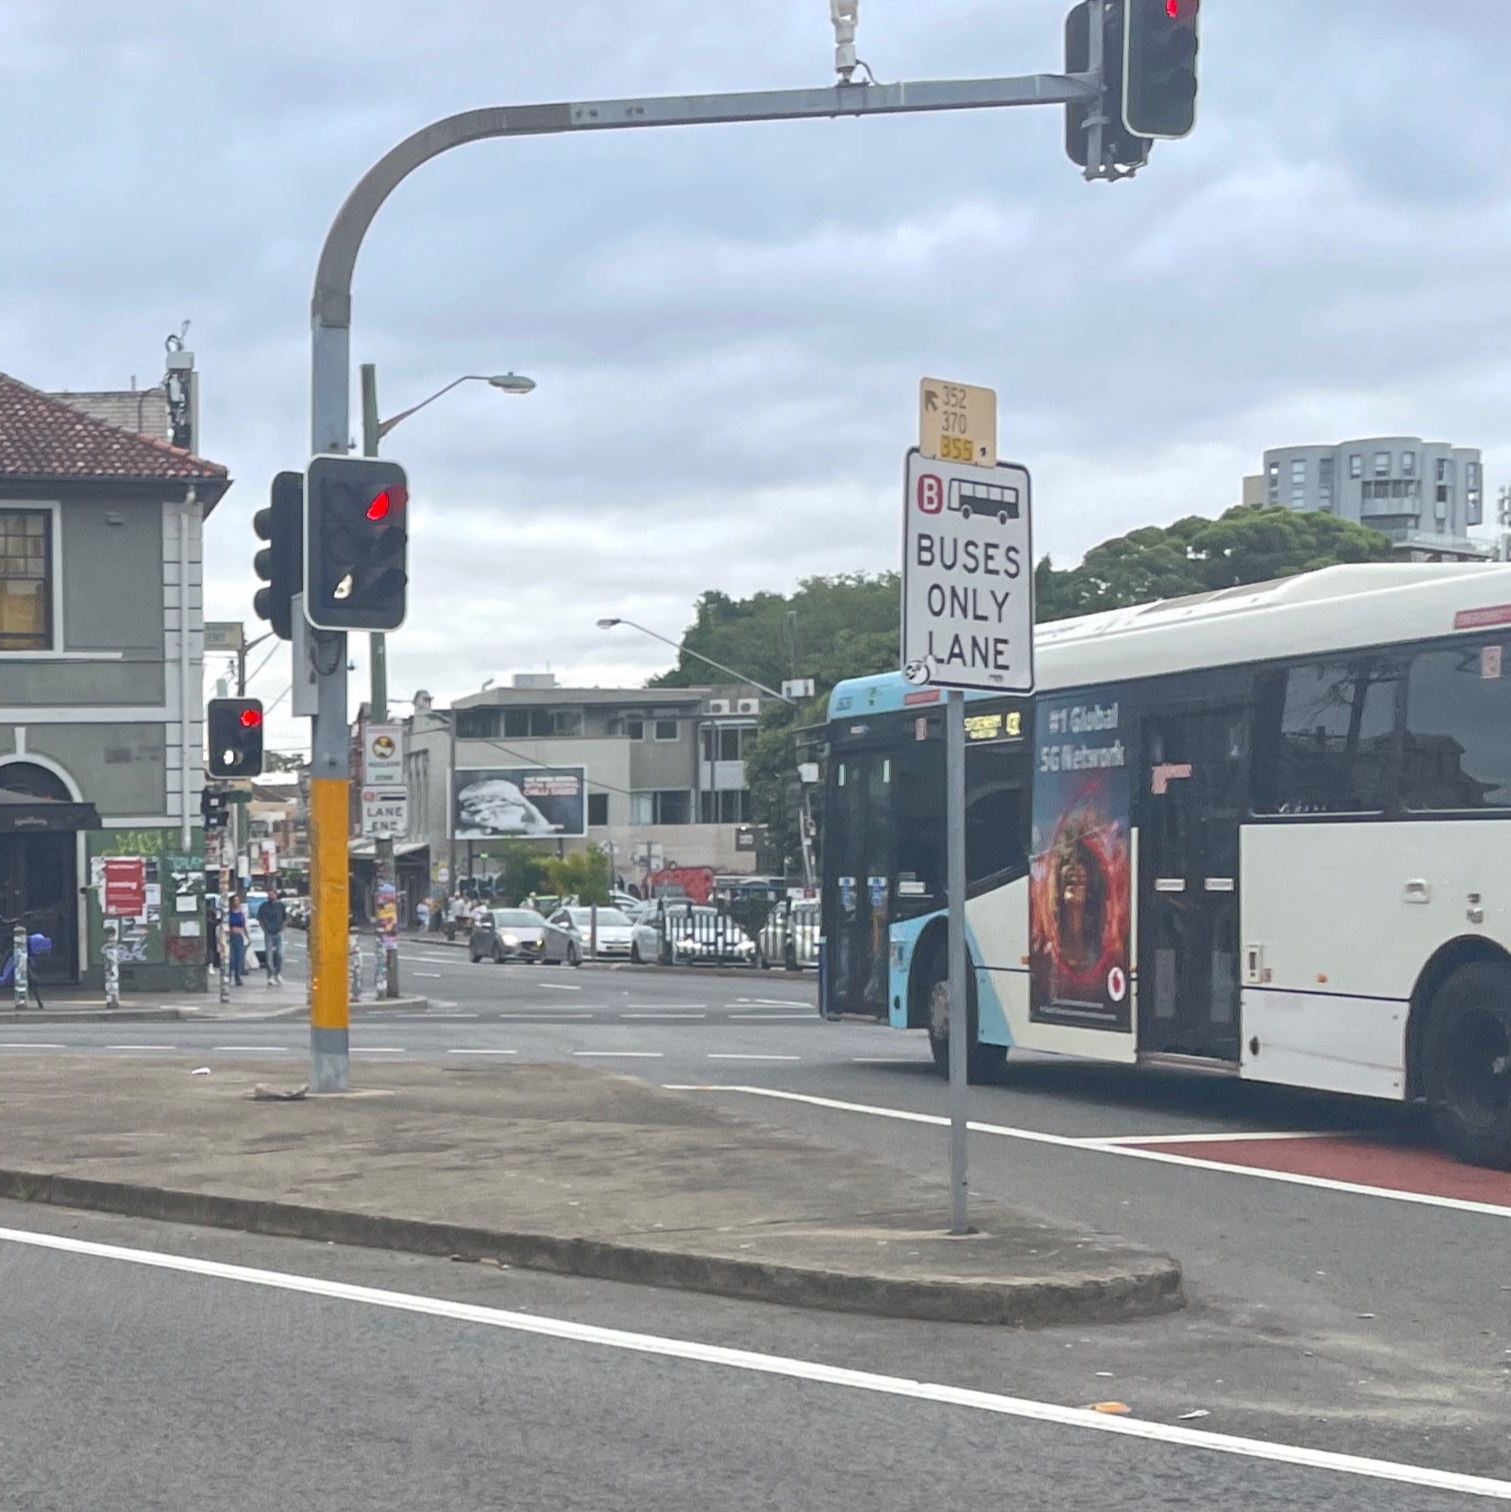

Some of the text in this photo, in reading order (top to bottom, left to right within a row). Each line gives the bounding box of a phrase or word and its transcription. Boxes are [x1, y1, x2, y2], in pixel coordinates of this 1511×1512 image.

[942, 385, 968, 410] 352
[941, 410, 968, 435] 370
[917, 533, 1021, 579] BUSES
[927, 583, 1011, 624] ONLY
[928, 630, 1010, 671] LANE
[366, 806, 403, 818] LANE
